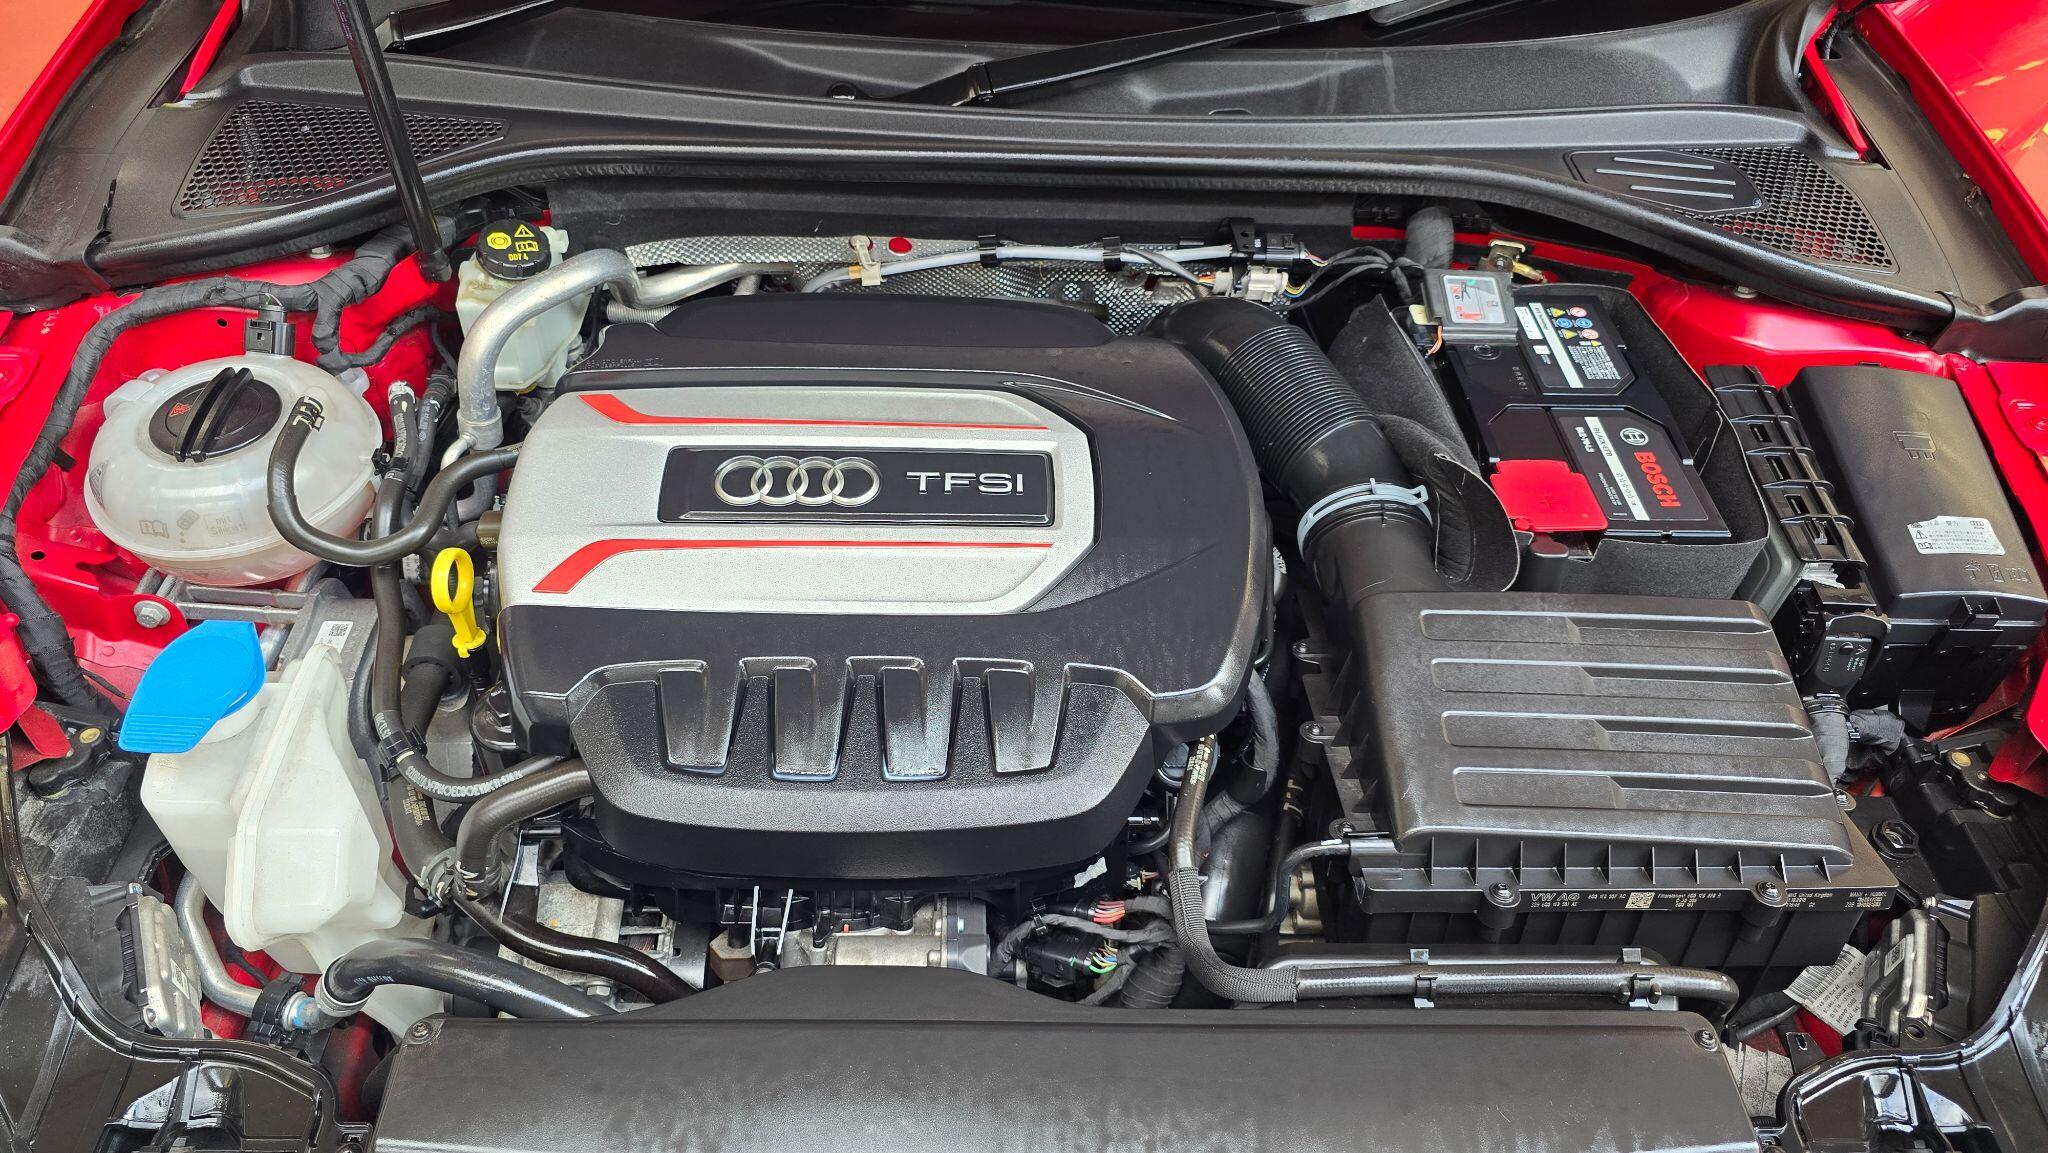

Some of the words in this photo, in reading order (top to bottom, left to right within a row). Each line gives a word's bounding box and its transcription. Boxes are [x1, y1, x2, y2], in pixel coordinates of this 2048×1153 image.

[508, 253, 522, 262] DOT
[523, 252, 529, 260] 4
[906, 471, 1024, 496] TFSI
[1633, 451, 1681, 507] BOSCH
[1530, 892, 1557, 902] VW
[1556, 892, 1580, 902] AG
